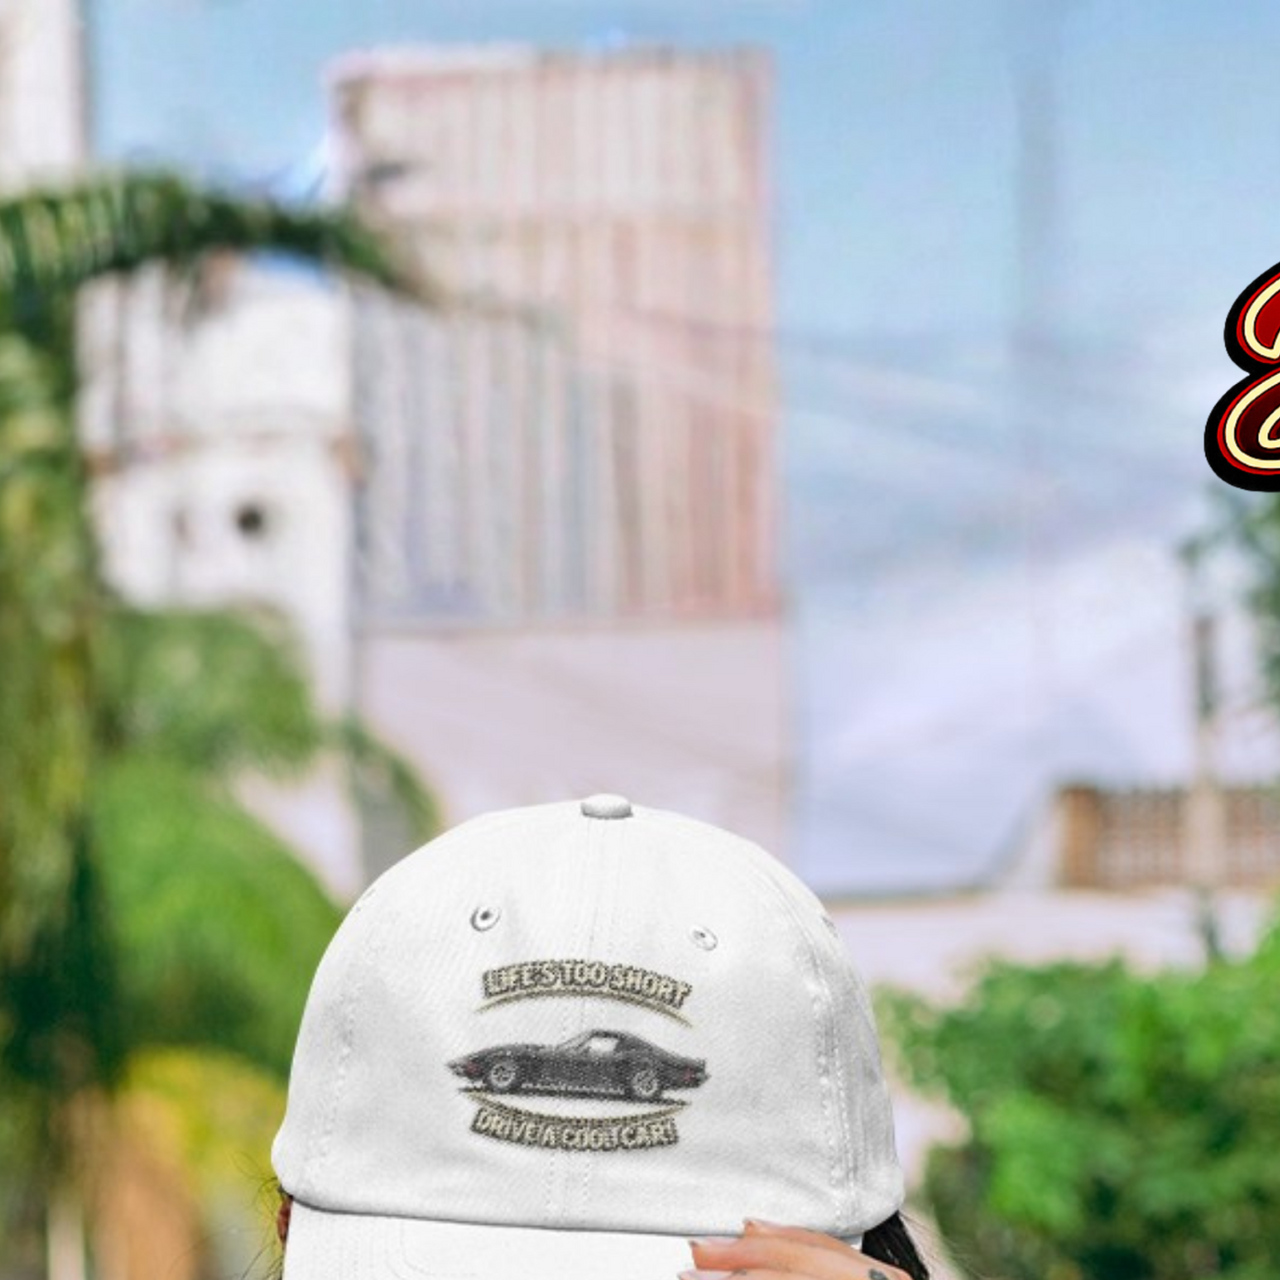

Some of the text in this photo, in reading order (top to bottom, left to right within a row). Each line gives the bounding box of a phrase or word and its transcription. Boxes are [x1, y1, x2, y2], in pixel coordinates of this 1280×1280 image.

[484, 960, 692, 1007] LIFE'S TOO SHORT
[472, 1106, 540, 1145] DRIVE
[541, 1123, 557, 1147] A
